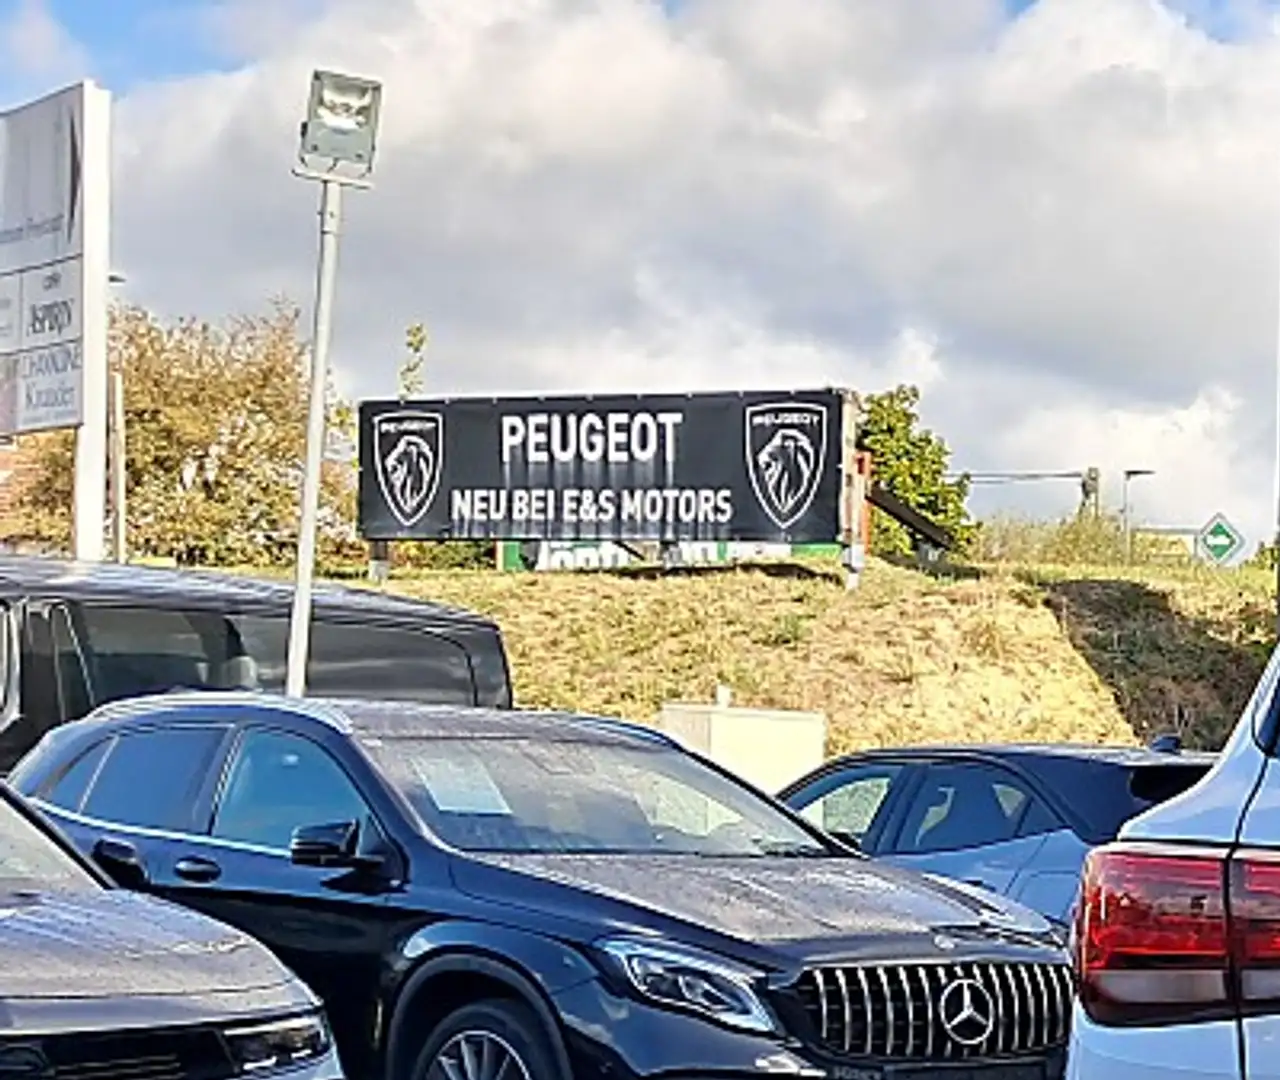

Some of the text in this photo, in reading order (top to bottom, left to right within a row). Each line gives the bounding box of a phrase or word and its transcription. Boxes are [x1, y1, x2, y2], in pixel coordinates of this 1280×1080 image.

[752, 412, 820, 426] PEUGEOT
[502, 412, 683, 462] PEUGEOT
[453, 488, 733, 523] NEU BEI E&S MOTORS
